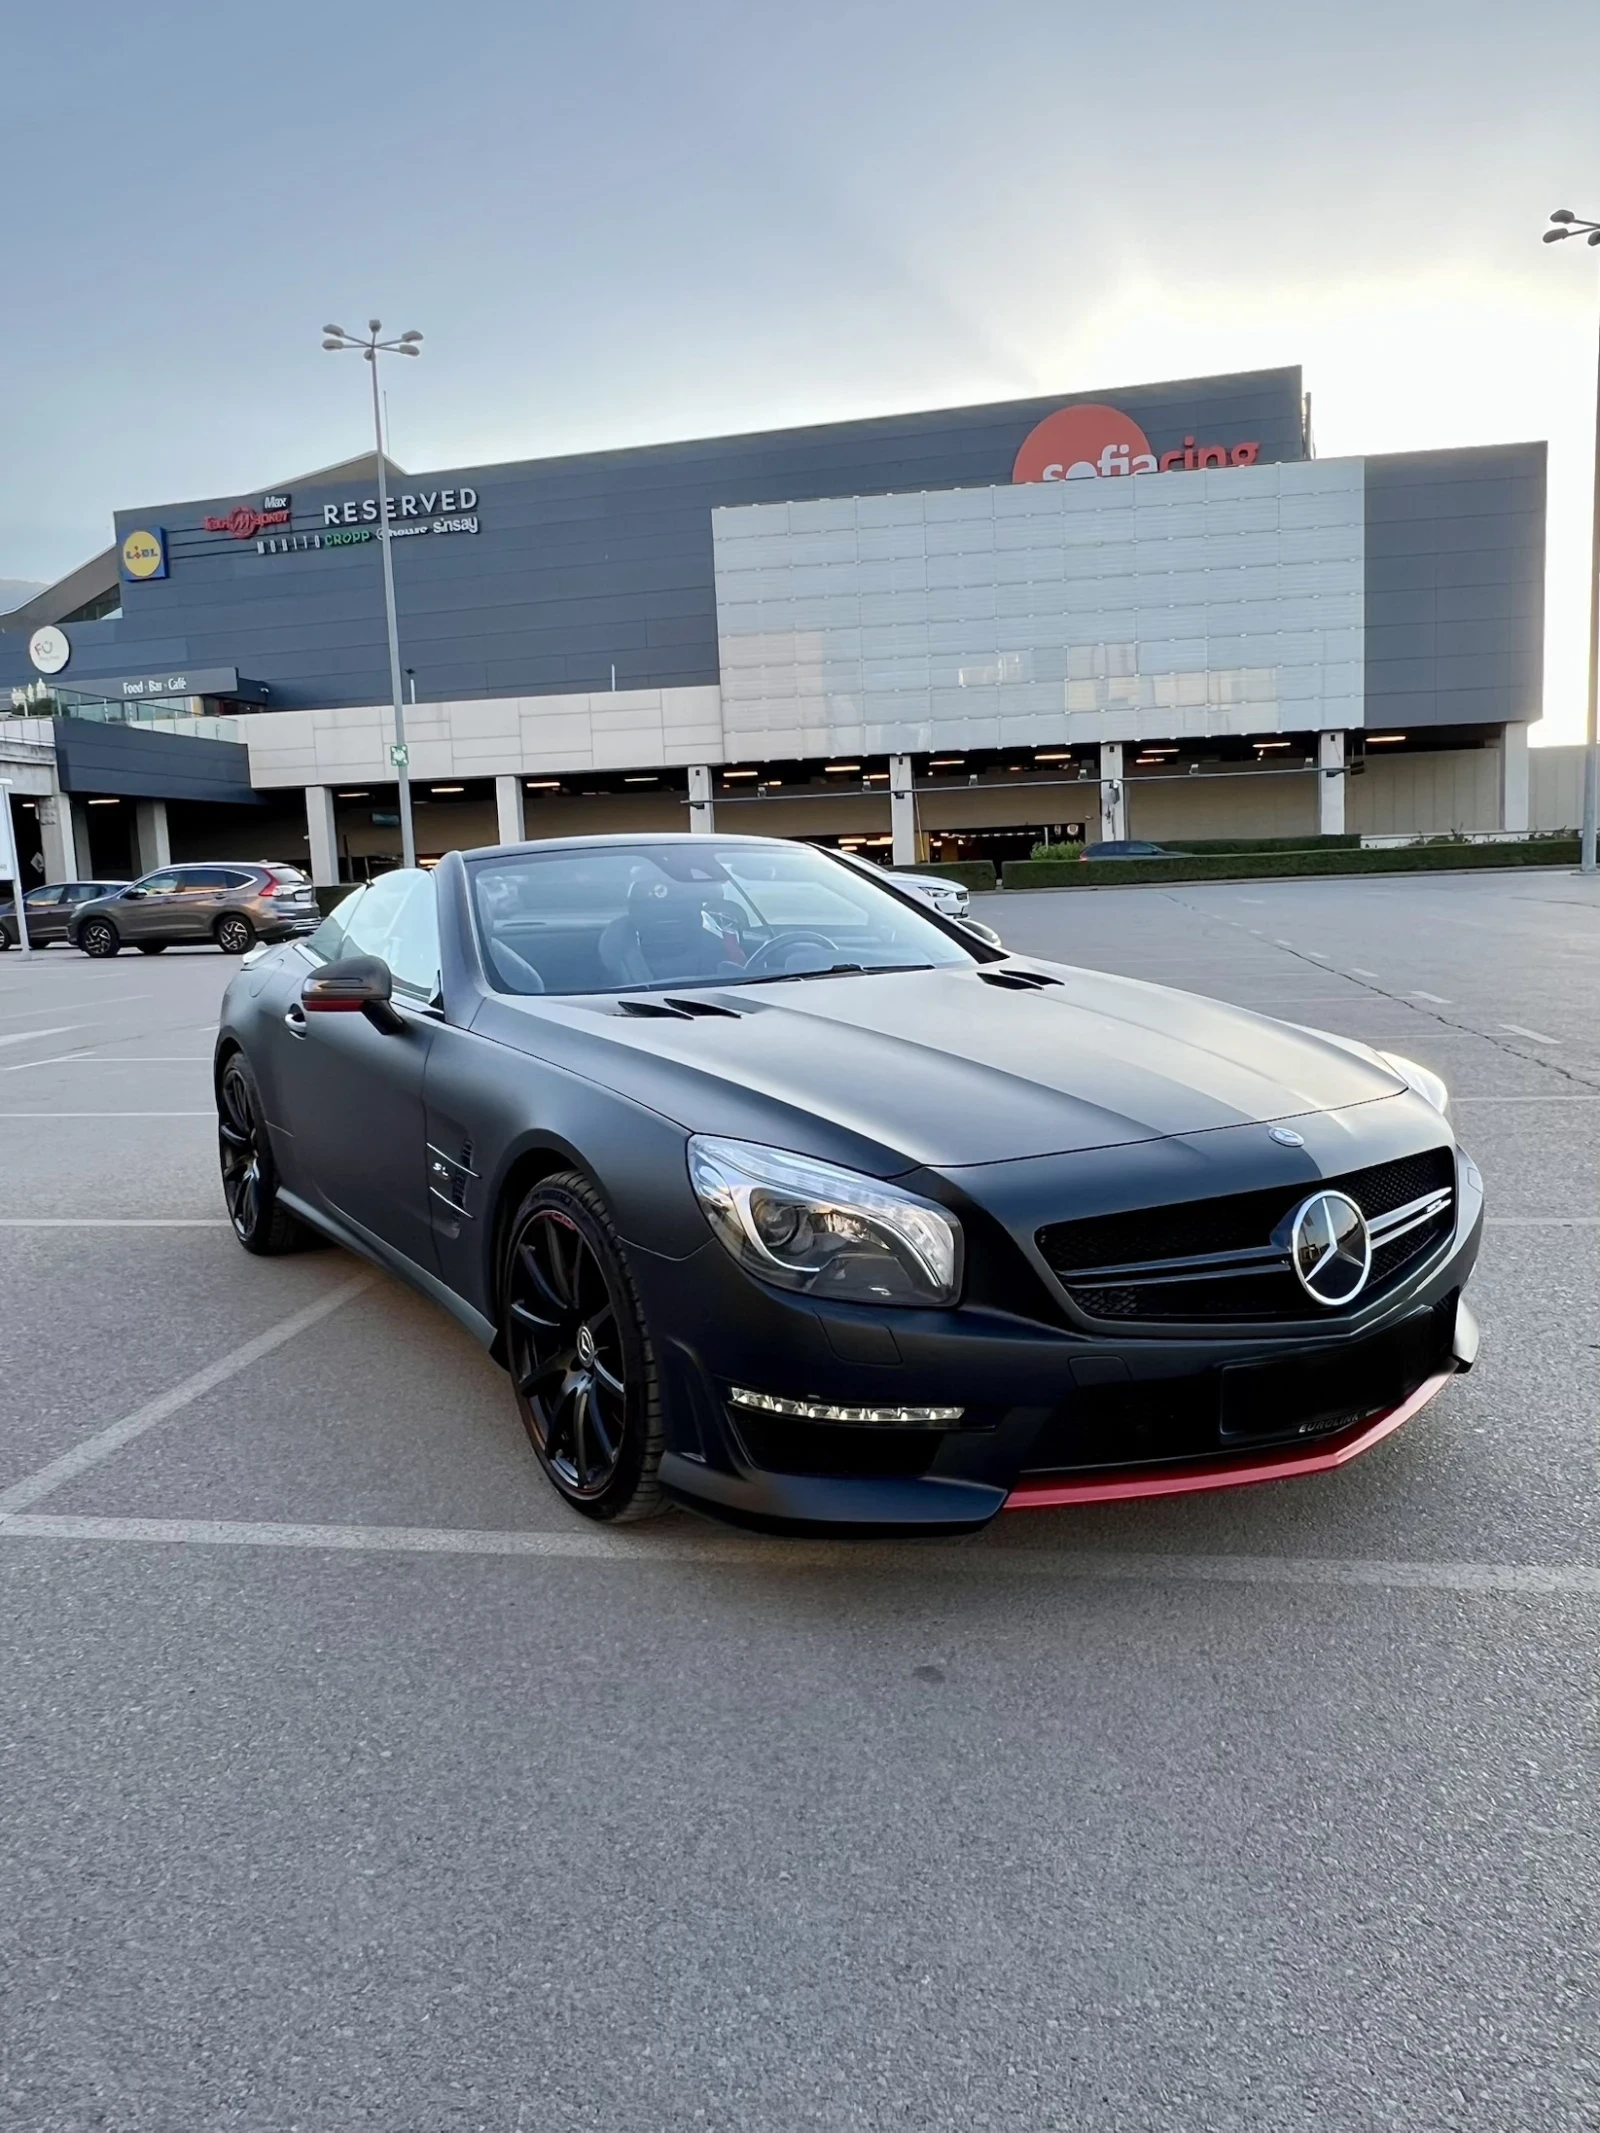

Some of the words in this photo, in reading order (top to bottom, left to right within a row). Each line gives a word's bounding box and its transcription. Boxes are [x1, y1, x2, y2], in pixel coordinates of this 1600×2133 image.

[264, 496, 287, 509] Max
[323, 487, 477, 525] RESERVED
[256, 535, 320, 554] MOHITO
[325, 530, 370, 546] CROPP
[433, 517, 478, 534] sinsay
[123, 680, 144, 694] Food
[148, 680, 163, 692] Bar
[168, 677, 187, 690] Café
[1299, 1414, 1360, 1433] EUROLINK
